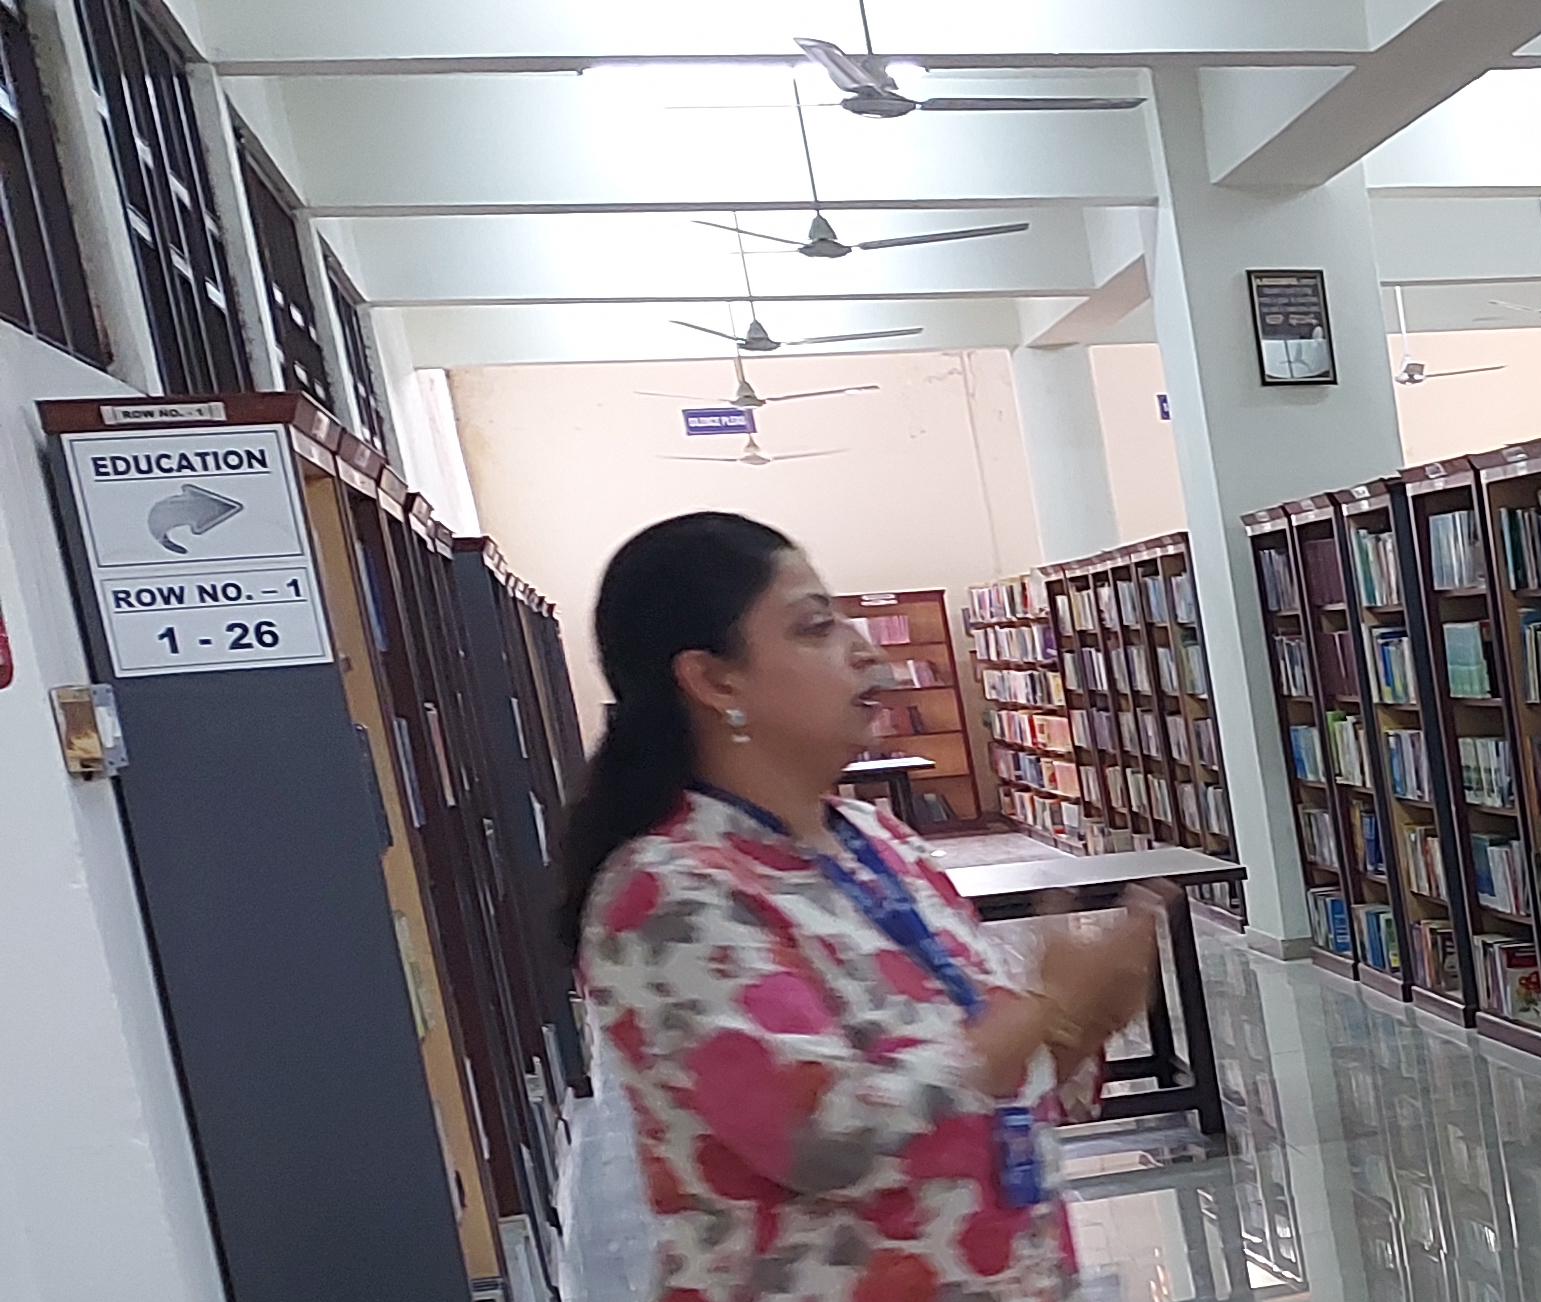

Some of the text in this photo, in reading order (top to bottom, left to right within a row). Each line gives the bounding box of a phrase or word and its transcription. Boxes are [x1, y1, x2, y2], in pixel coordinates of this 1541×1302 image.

[121, 410, 155, 419] ROW
[91, 447, 269, 478] EDUCATION
[112, 584, 186, 610] ROW
[197, 581, 254, 605] NO.
[286, 577, 302, 599] 1
[157, 625, 180, 655] 1
[225, 619, 281, 650] 26
